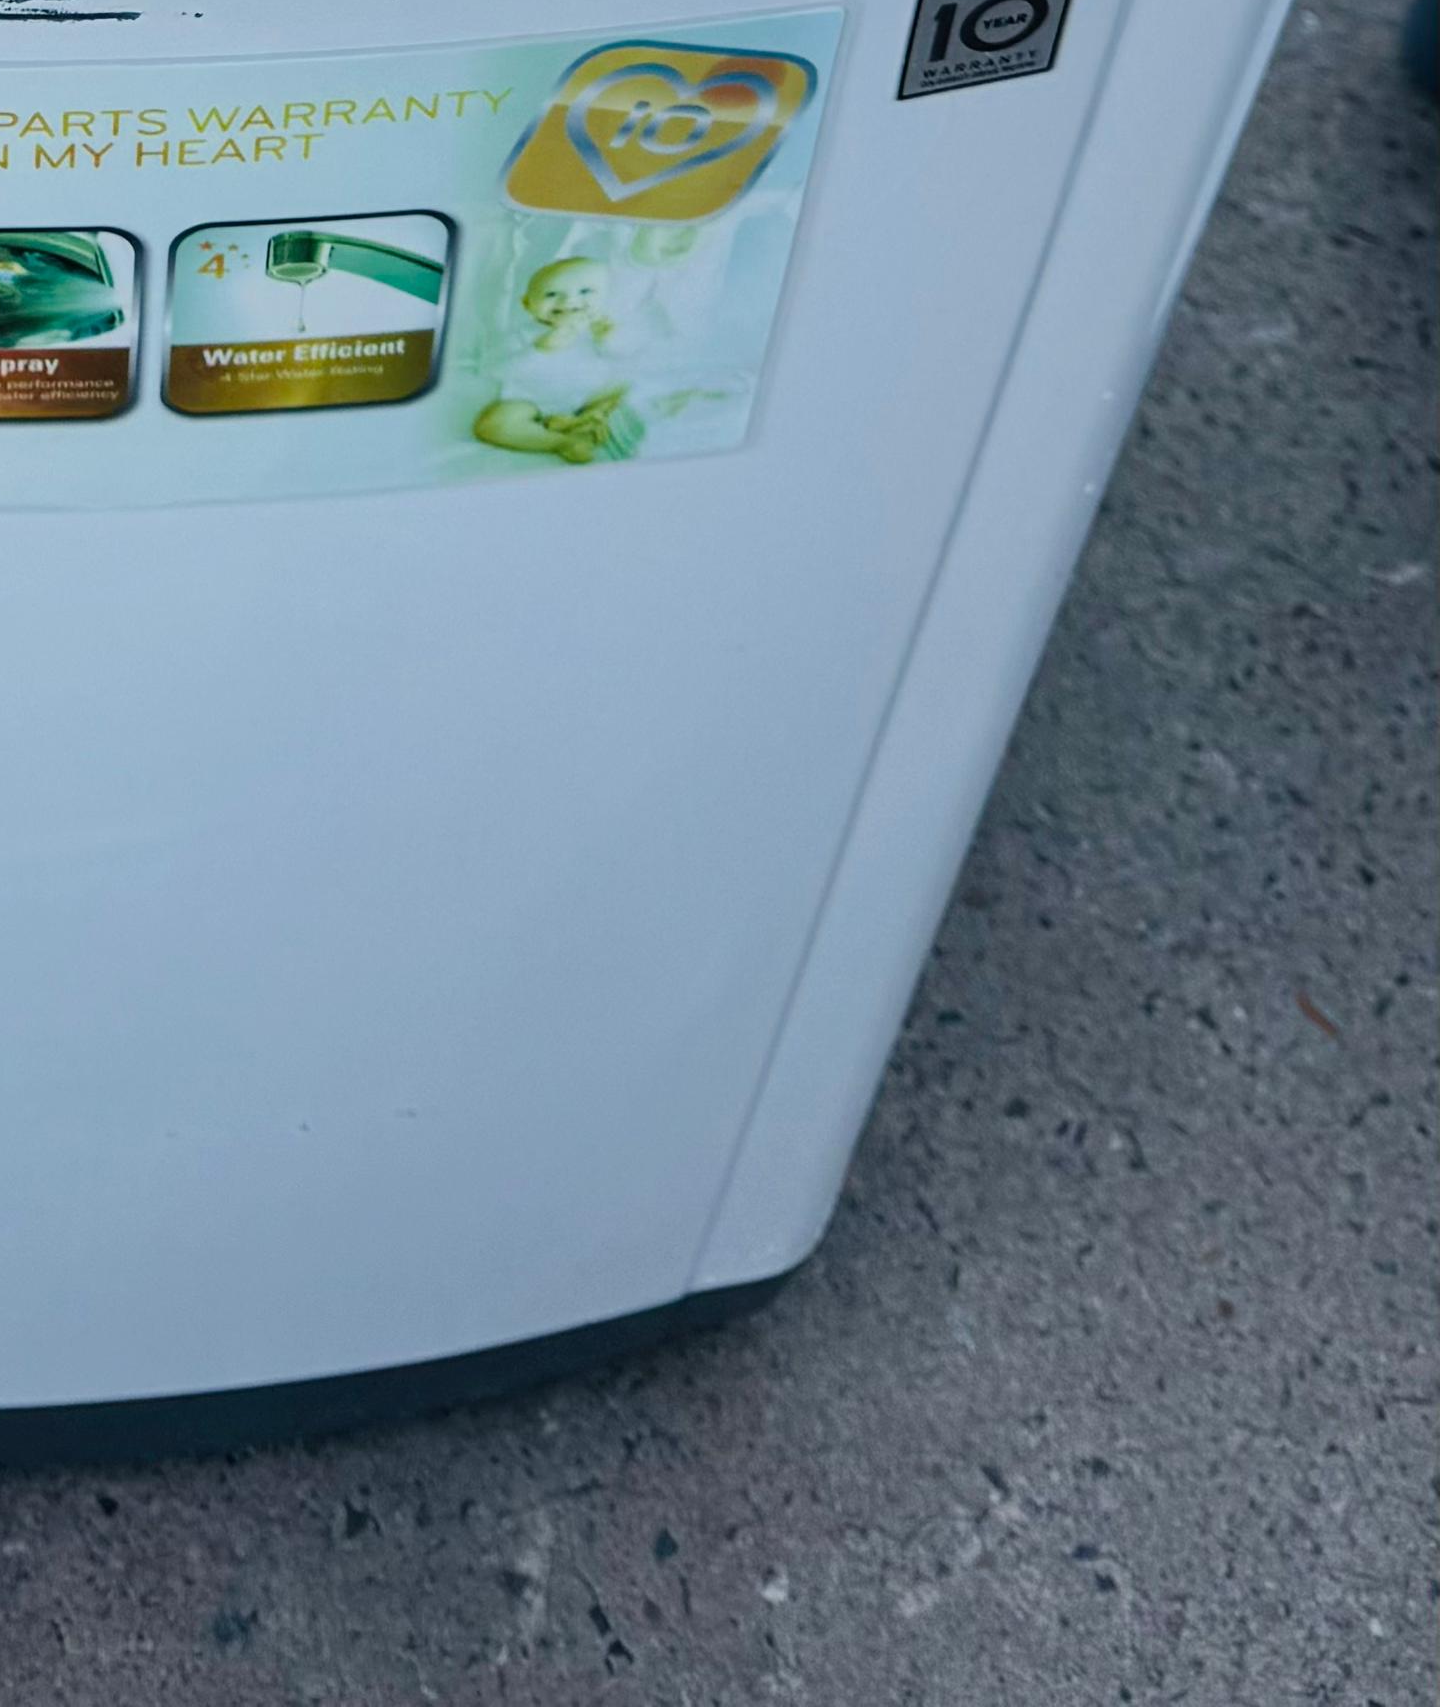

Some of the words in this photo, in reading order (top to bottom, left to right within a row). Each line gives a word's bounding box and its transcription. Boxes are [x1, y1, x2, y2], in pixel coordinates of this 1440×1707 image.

[983, 12, 1028, 30] YEAR
[187, 87, 515, 135] WARRANTY
[33, 141, 114, 170] MY
[135, 132, 325, 168] HEART
[197, 253, 226, 279] 4
[203, 347, 287, 367] Water
[293, 338, 406, 364] Efficient
